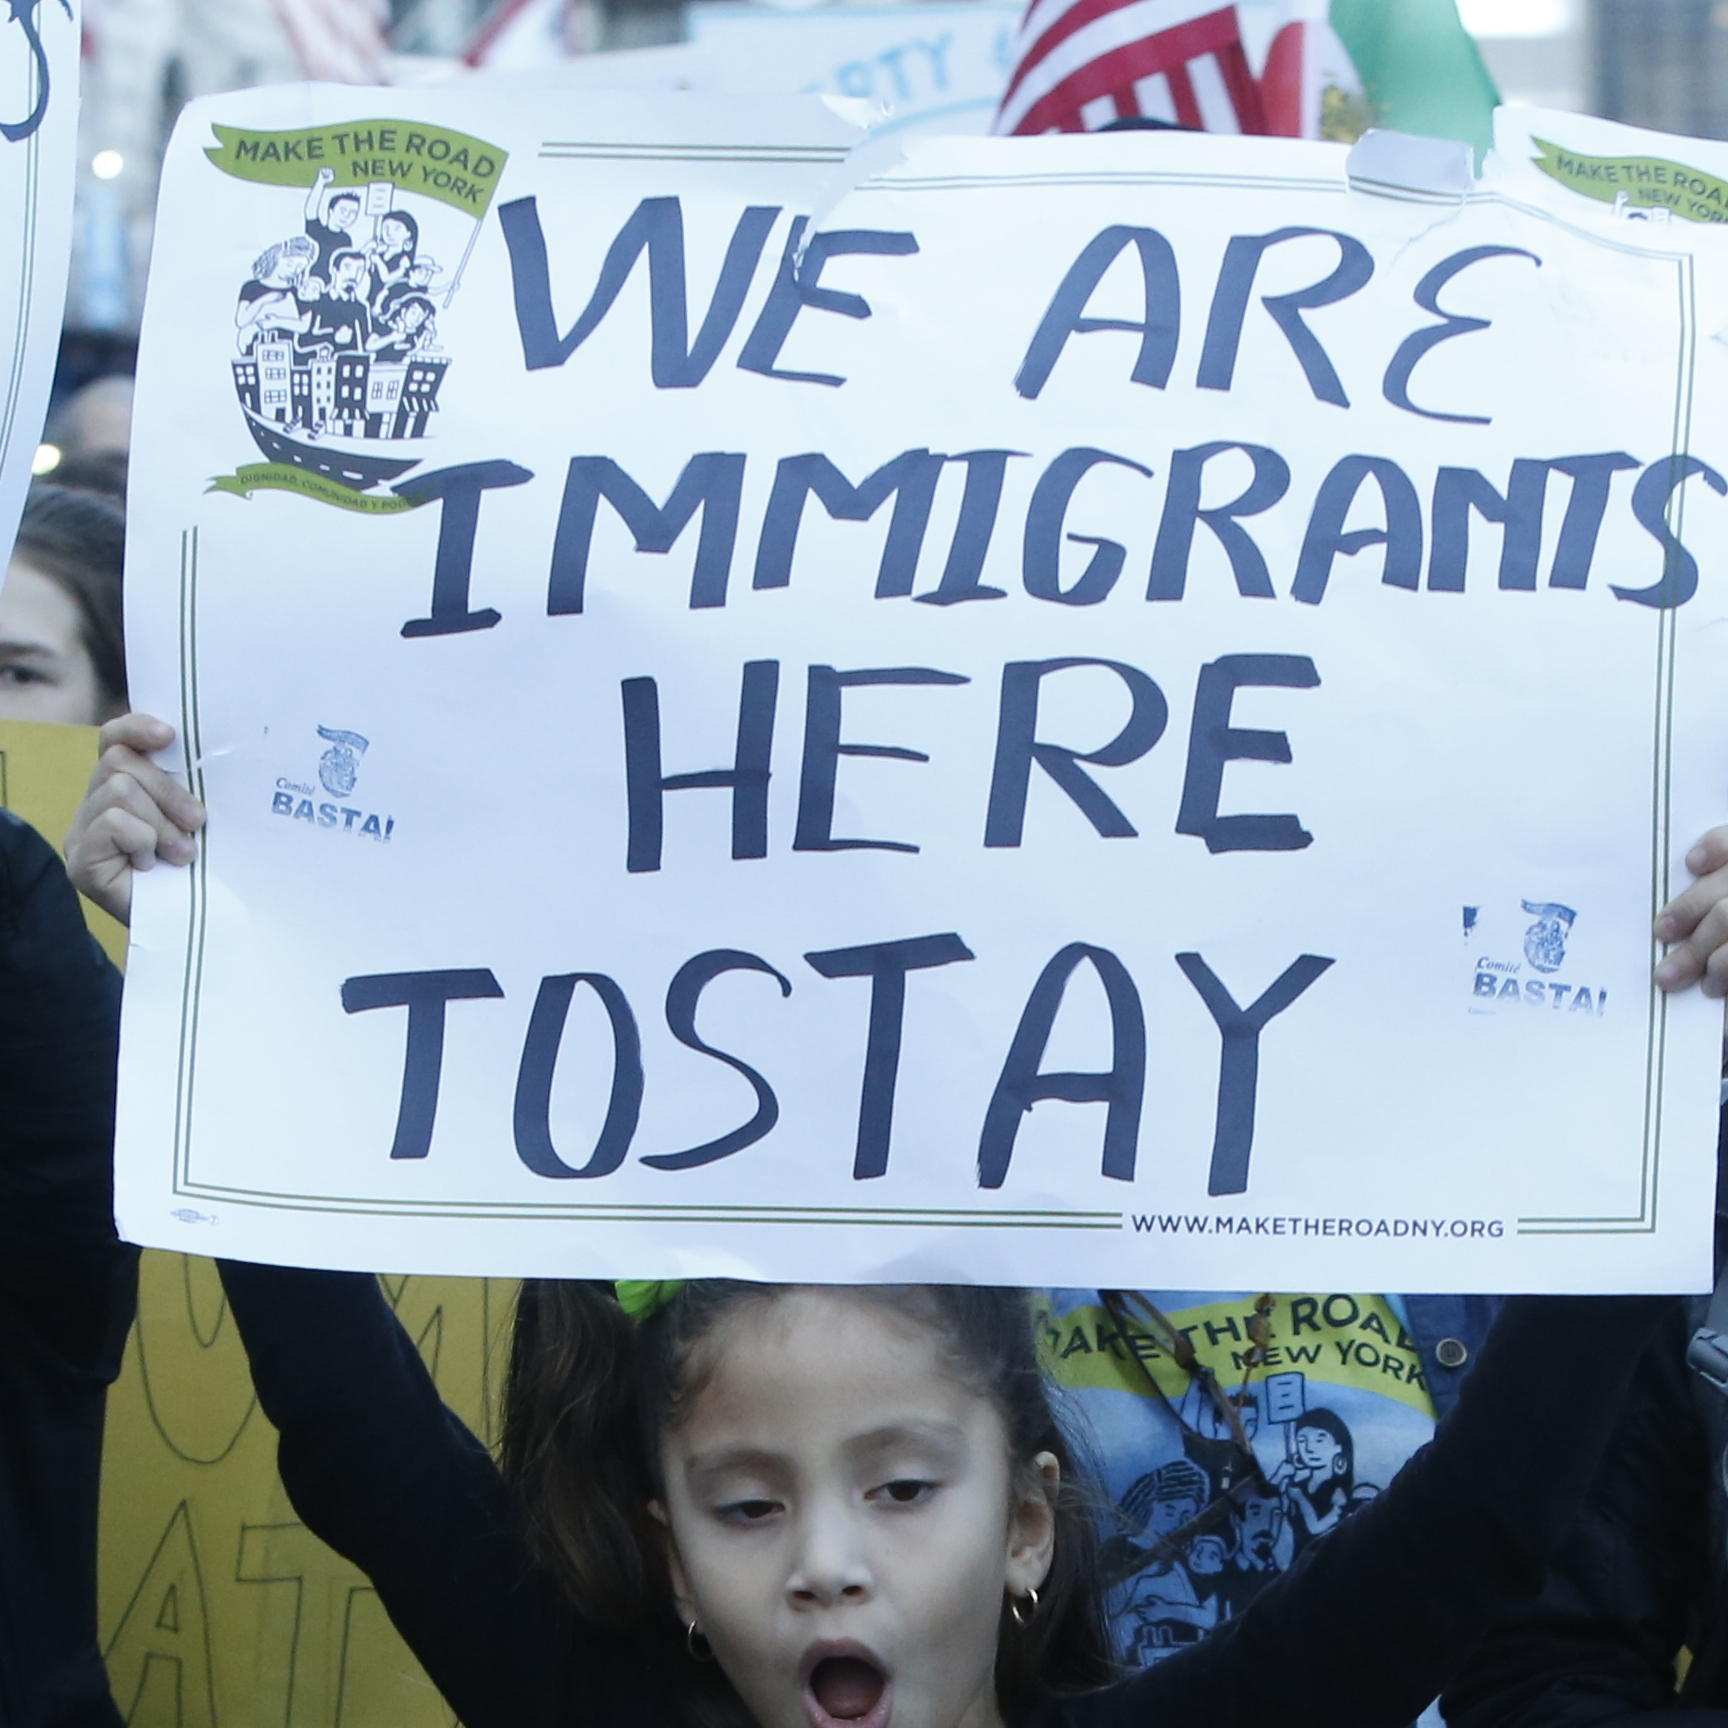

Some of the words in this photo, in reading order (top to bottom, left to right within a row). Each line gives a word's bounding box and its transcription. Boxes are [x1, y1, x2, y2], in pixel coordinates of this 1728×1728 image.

[235, 138, 324, 162] MAKE
[332, 129, 398, 155] THE
[405, 132, 496, 178] ROAD
[1556, 154, 1618, 183] MAKE
[1622, 165, 1667, 184] THE
[351, 159, 413, 178] NEW
[421, 166, 485, 203] YORK
[1637, 187, 1681, 206] NEW
[497, 195, 920, 388] WE
[1012, 223, 1542, 426] ARE
[399, 441, 1728, 639] IMMIGRANTS
[621, 653, 1322, 873] HERE
[272, 791, 394, 842] BASTA!
[1476, 956, 1521, 973] Comité
[1473, 972, 1608, 1016] BASTA!
[1130, 1213, 1505, 1240] WWW.MAKETHEROADNY.ORG
[1335, 1339, 1427, 1391] YORK
